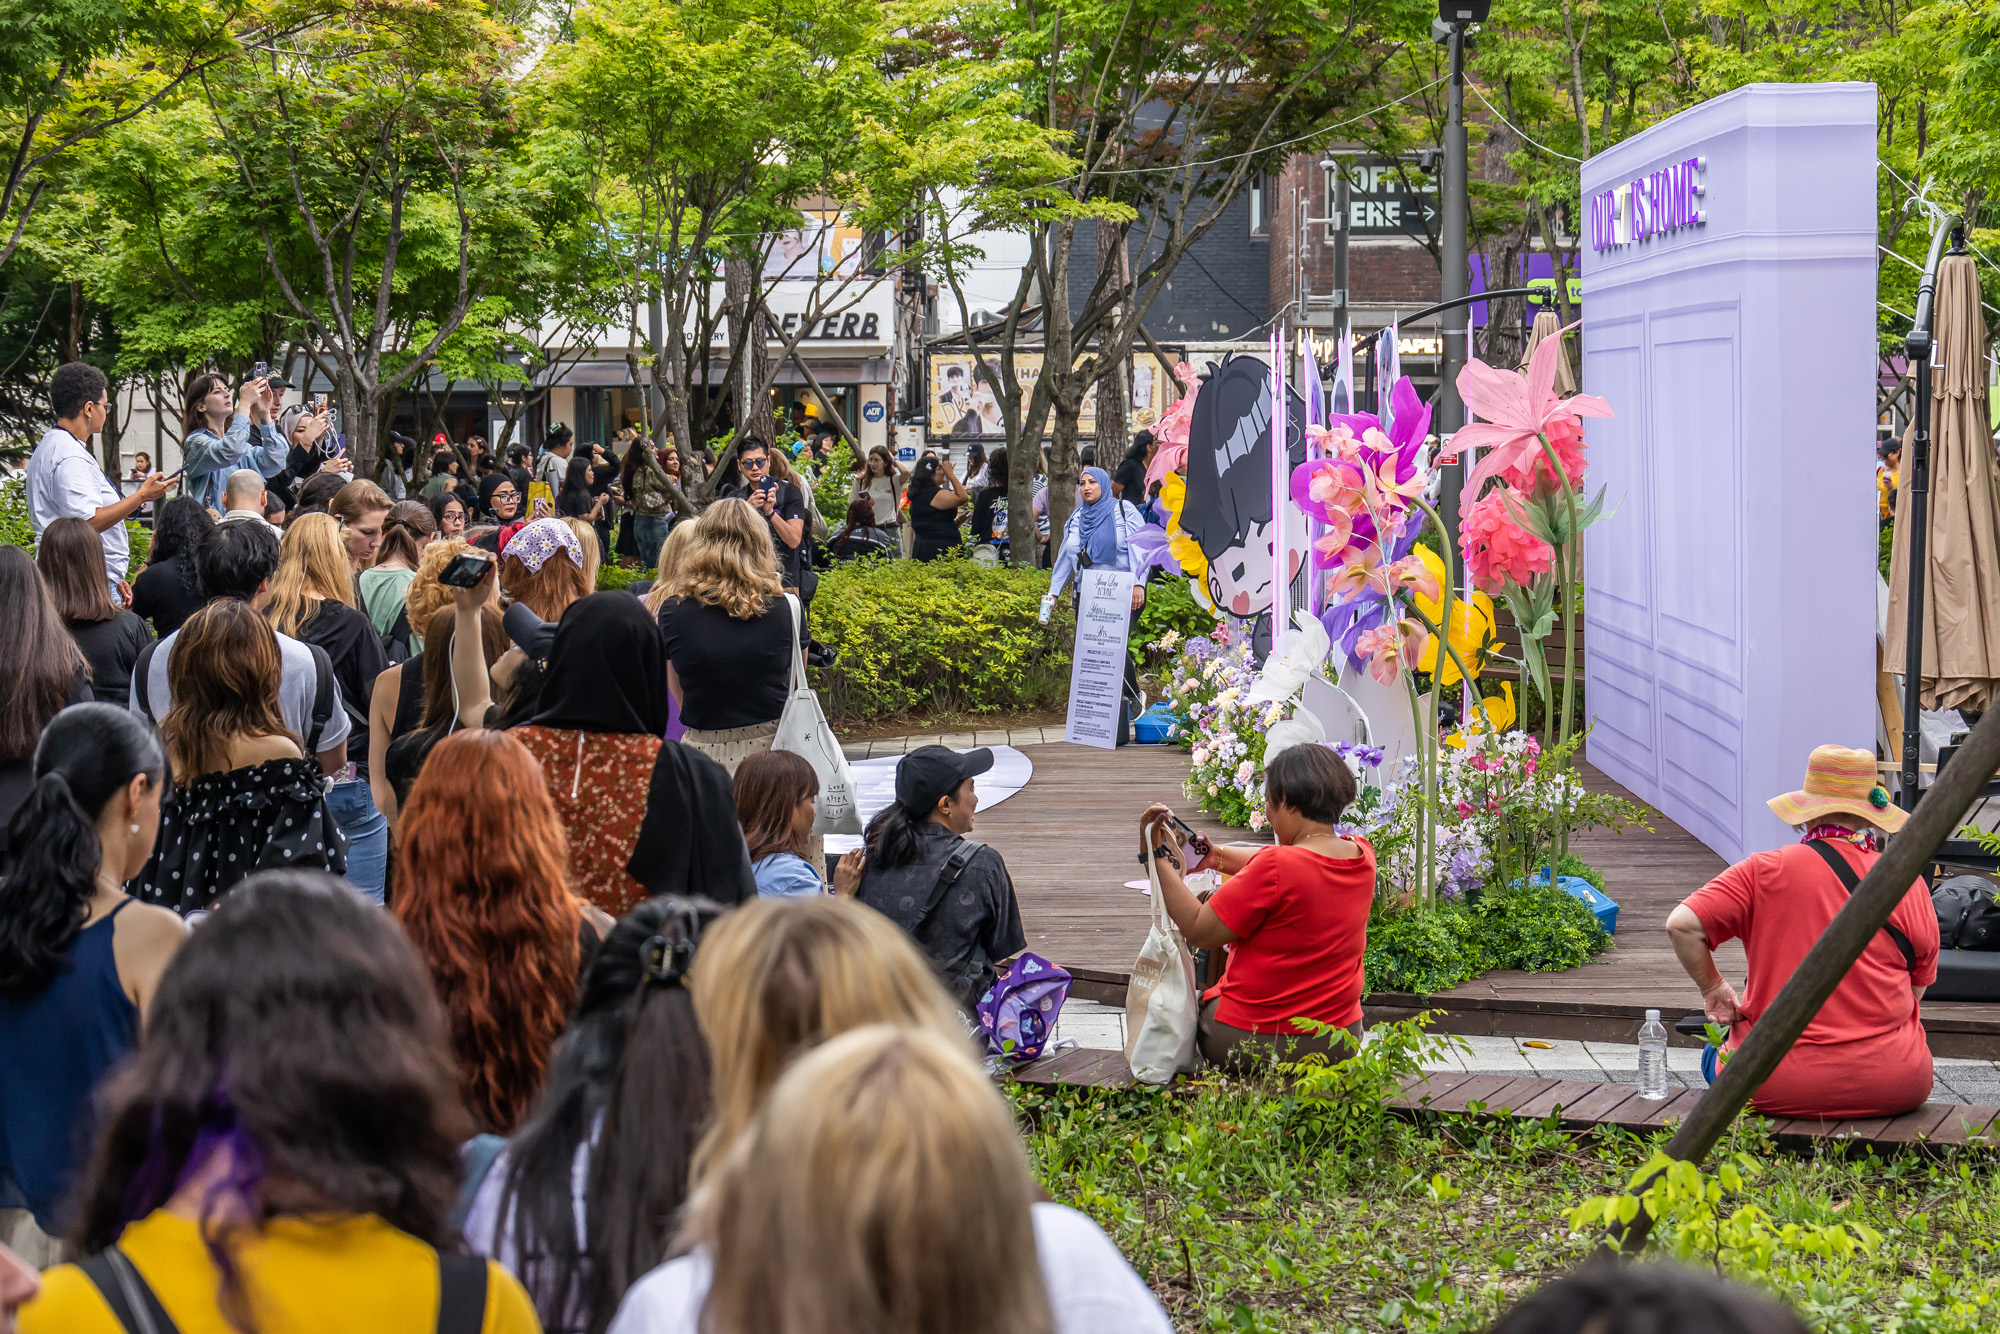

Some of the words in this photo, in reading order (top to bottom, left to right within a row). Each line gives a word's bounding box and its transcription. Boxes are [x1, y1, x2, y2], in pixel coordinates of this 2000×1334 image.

[1631, 177, 1647, 240] IS
[1650, 157, 1703, 234] HOME
[1332, 201, 1400, 227] ERE
[1297, 327, 1323, 360] bby
[866, 407, 881, 416] ADT
[1148, 966, 1160, 977] US
